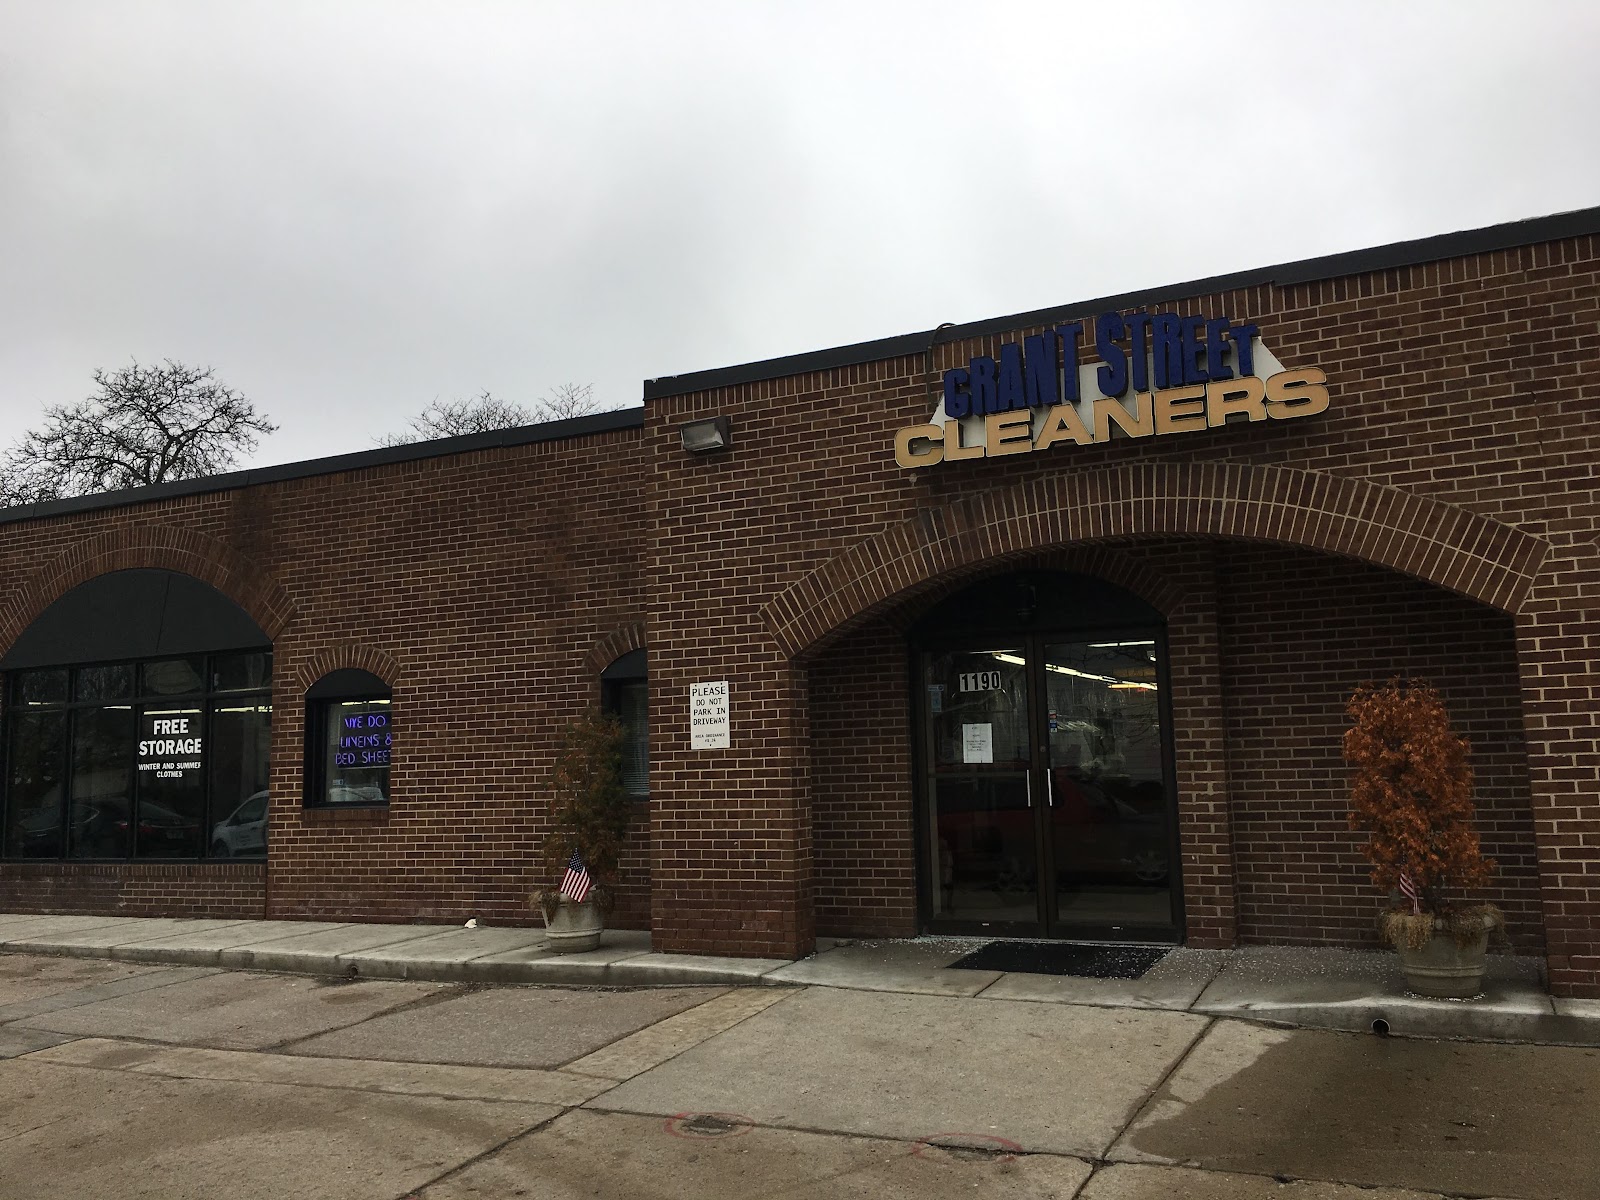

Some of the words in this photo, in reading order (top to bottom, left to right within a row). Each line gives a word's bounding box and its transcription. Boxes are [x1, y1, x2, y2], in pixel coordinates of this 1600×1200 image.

[944, 322, 1084, 419] GRANT
[1096, 310, 1260, 398] STREET
[894, 366, 1330, 469] CLEANERS
[961, 672, 1001, 691] 1190
[692, 686, 726, 697] PLEASE
[694, 708, 712, 716] PARK
[716, 707, 726, 715] IN
[153, 718, 189, 735] FREE
[344, 716, 363, 728] WE
[368, 715, 386, 728] DO
[693, 717, 726, 726] DRIVEWAY
[138, 738, 202, 756] STORAGE
[340, 733, 380, 748] LINENS
[336, 752, 356, 765] BED
